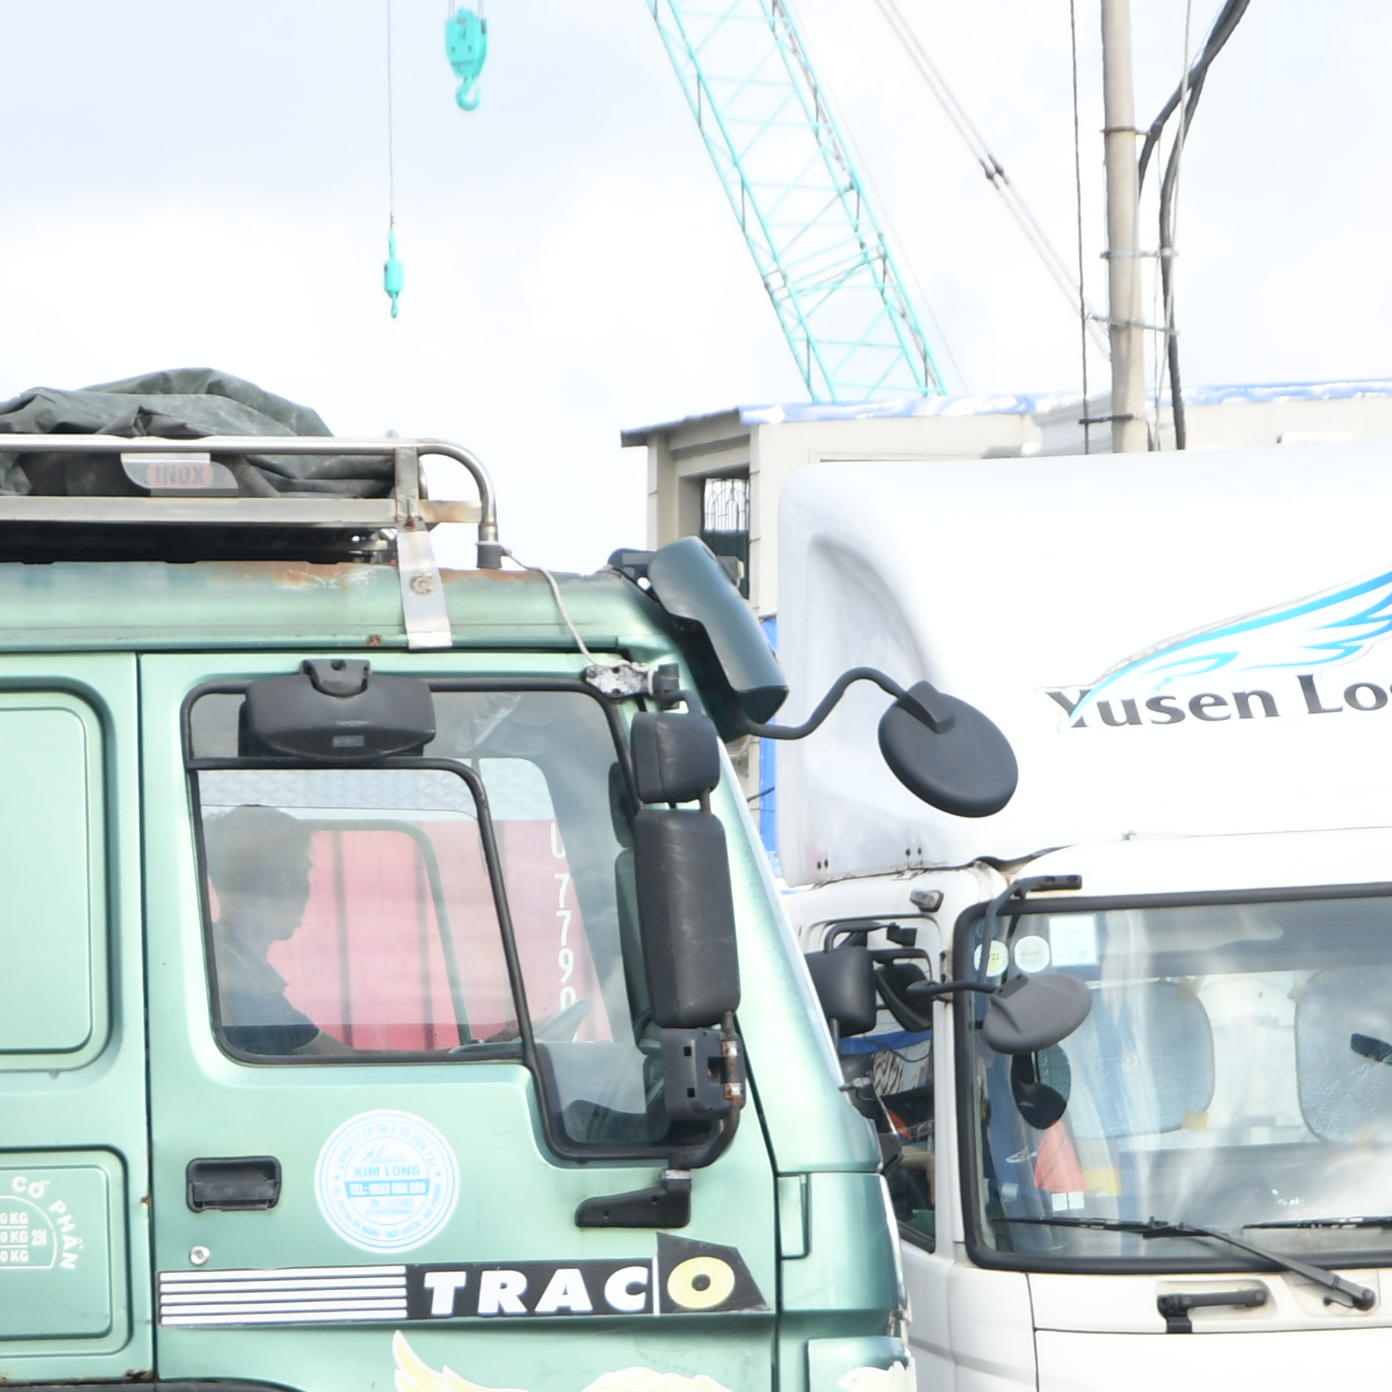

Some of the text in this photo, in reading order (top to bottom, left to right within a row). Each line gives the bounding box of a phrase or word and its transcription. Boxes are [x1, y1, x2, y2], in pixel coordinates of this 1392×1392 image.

[154, 464, 206, 484] INOX
[1045, 685, 1279, 729] Yusen
[354, 1165, 421, 1177] KIM LONG
[10, 1211, 29, 1225] KG
[10, 1229, 29, 1243] KG
[10, 1248, 30, 1263] KG
[423, 1255, 736, 1317] TRACO
